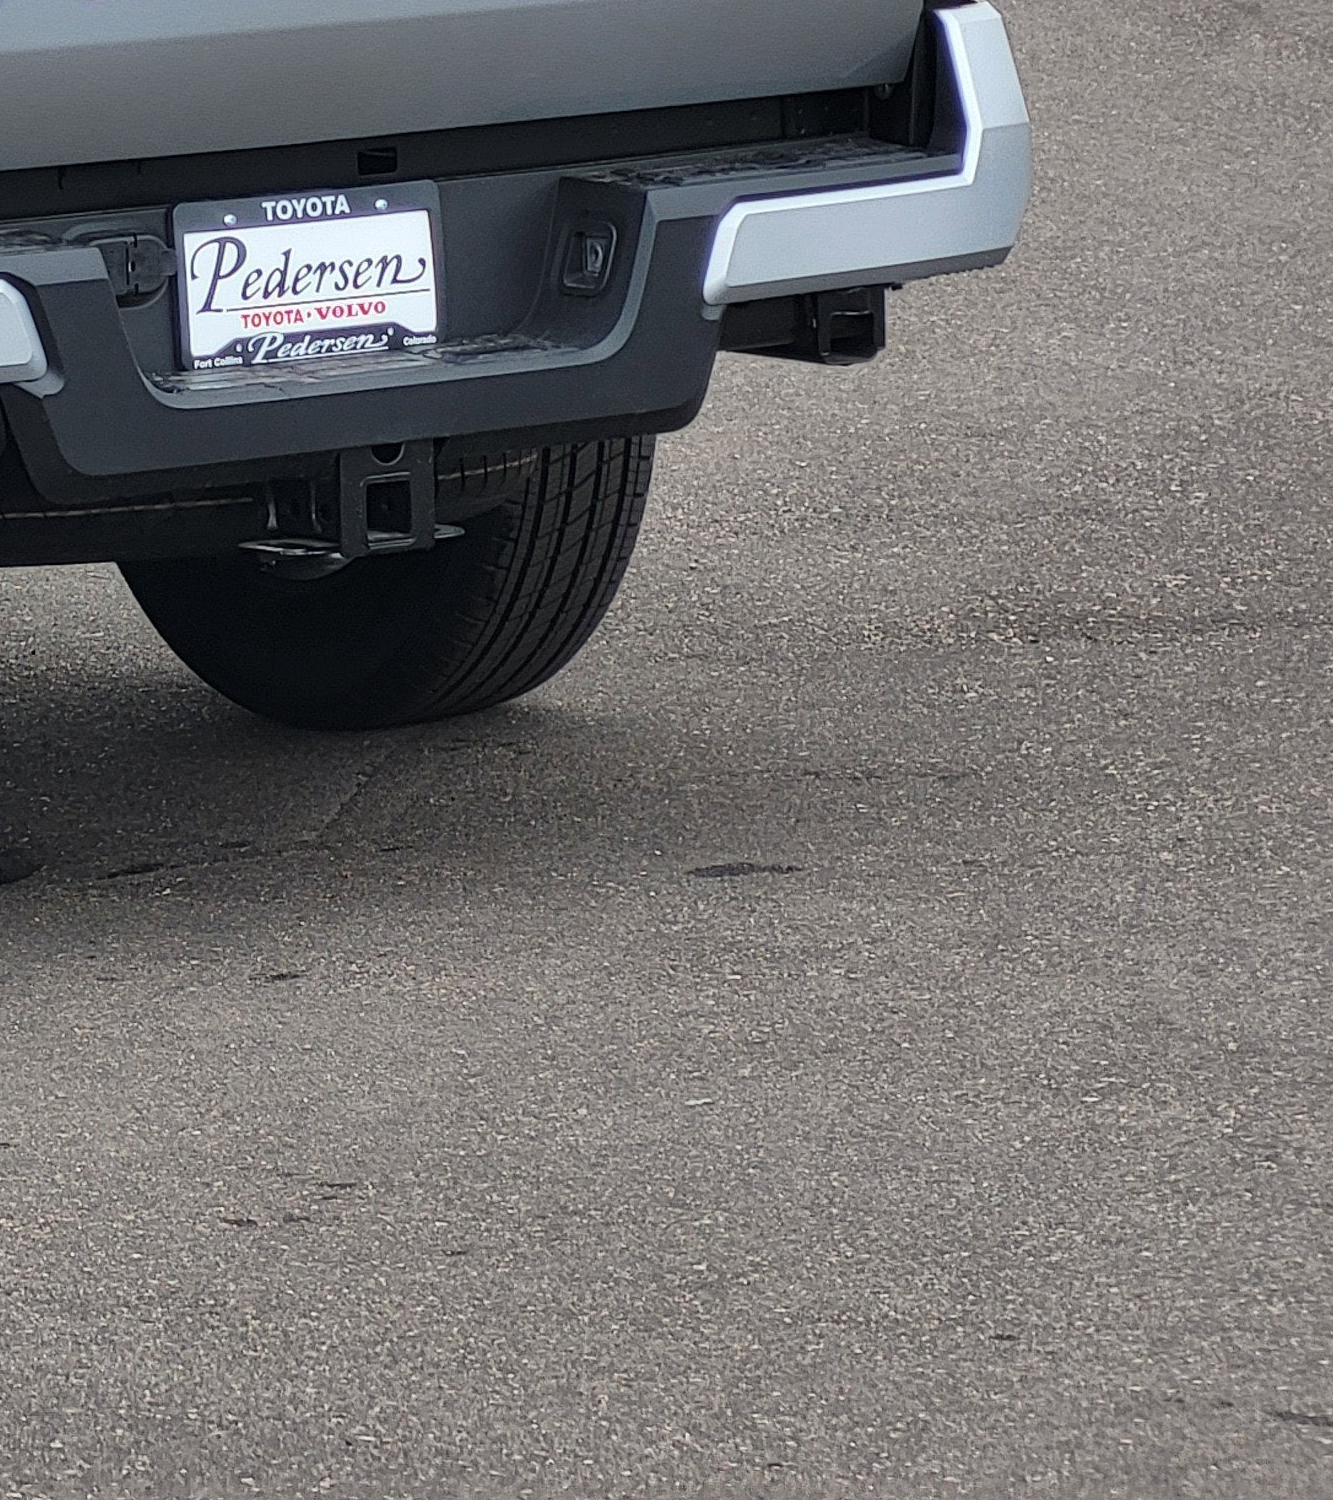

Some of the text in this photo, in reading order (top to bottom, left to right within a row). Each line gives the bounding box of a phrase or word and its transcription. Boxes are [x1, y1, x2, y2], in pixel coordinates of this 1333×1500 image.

[261, 194, 351, 222] TOYOTA
[190, 236, 427, 315] Pedersen
[240, 301, 387, 329] TOYOTA VOLVO
[248, 332, 389, 365] Pedersen
